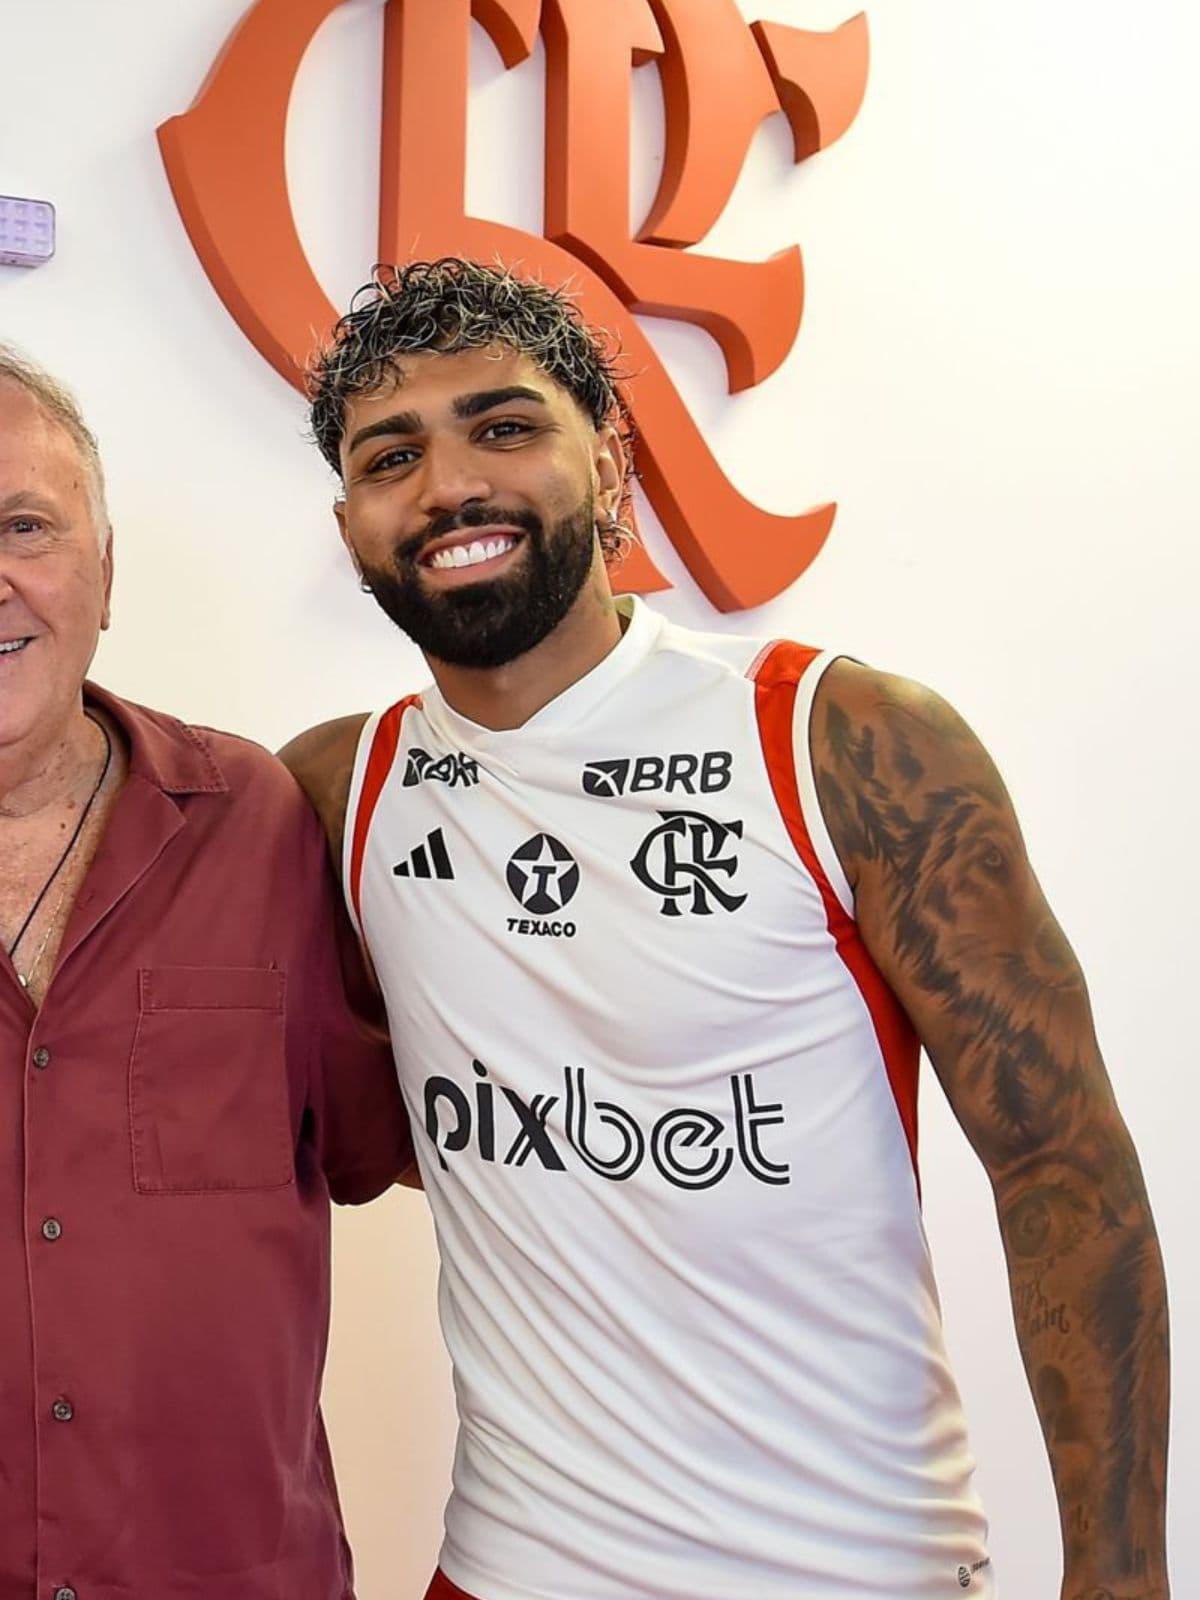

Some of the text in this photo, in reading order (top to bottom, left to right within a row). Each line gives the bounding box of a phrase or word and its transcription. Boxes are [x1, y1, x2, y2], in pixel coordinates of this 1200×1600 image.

[629, 750, 733, 795] BRB
[506, 918, 577, 938] TEXACO
[424, 1058, 791, 1190] pixbet
